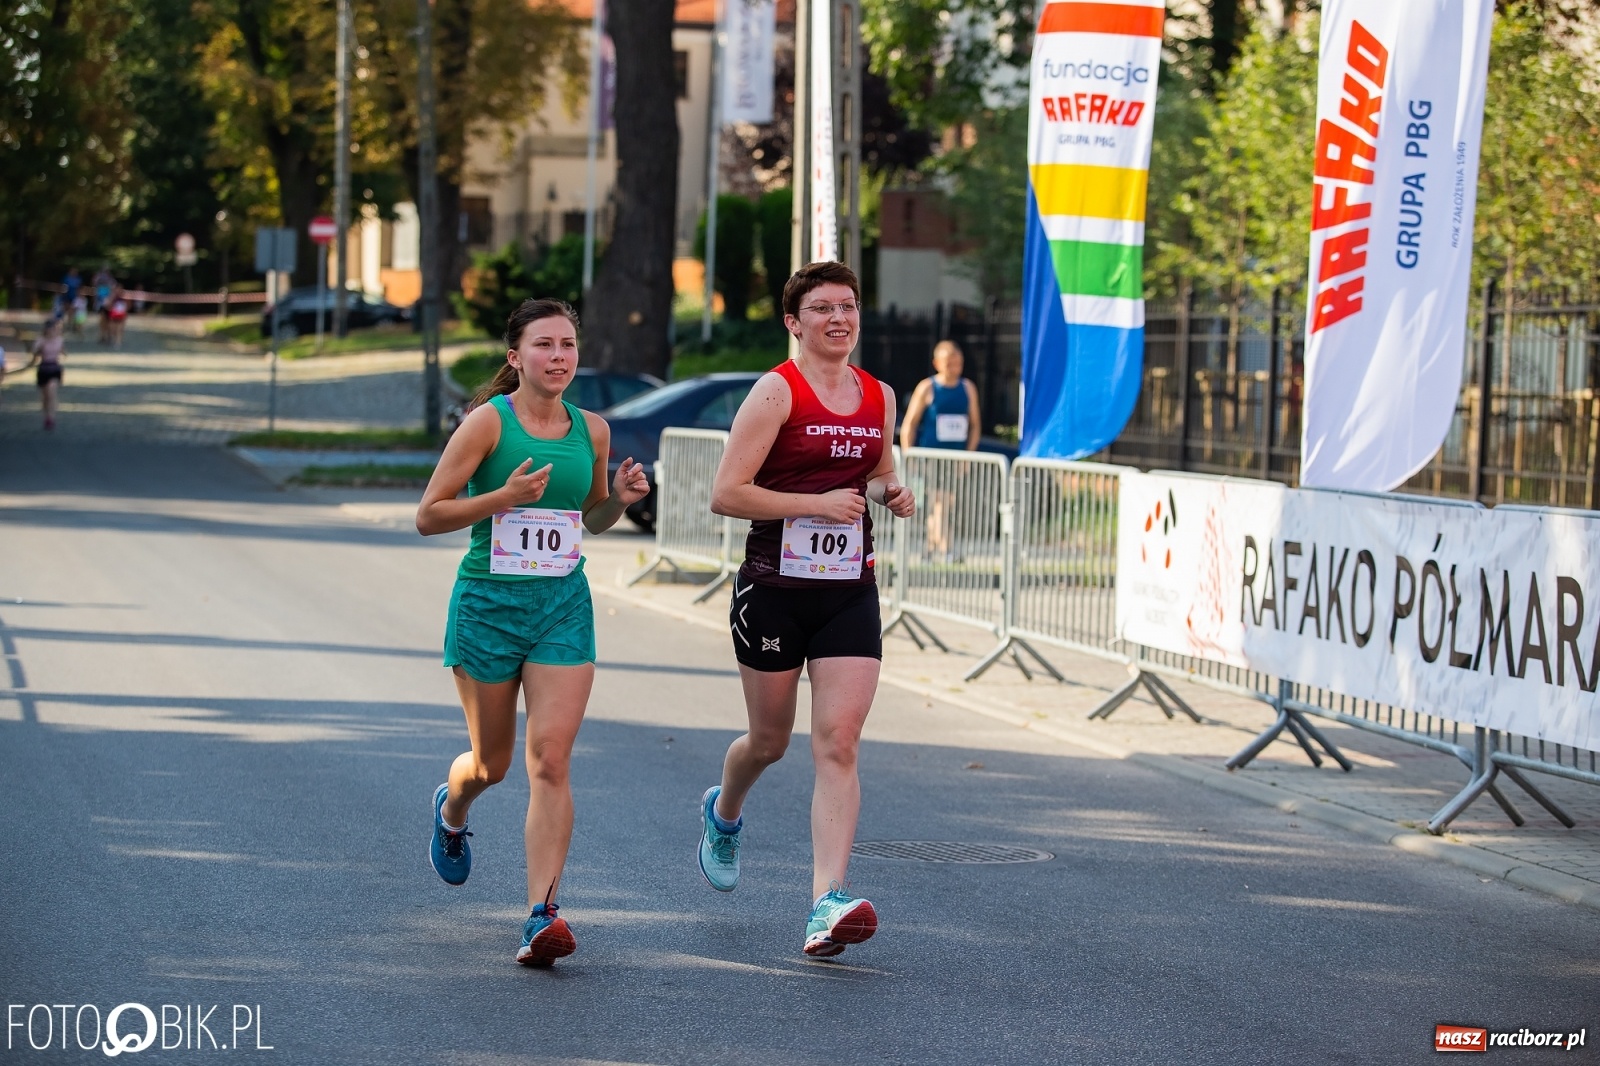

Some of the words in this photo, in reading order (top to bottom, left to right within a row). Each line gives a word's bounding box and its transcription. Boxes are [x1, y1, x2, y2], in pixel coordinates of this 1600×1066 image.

[1043, 58, 1149, 87] fundacja
[1042, 93, 1145, 127] RAFAKO
[1404, 99, 1432, 159] PBG
[1456, 141, 1466, 166] 1949
[1311, 19, 1389, 335] RAFAKO
[1452, 168, 1465, 224] ZAŁOŻENIA
[1395, 172, 1427, 270] GRUPA
[1451, 226, 1461, 249] ROK
[806, 425, 881, 439] DAR-BUD
[519, 527, 561, 552] 110
[810, 532, 848, 556] 109
[1241, 534, 1377, 649] RAFAKO
